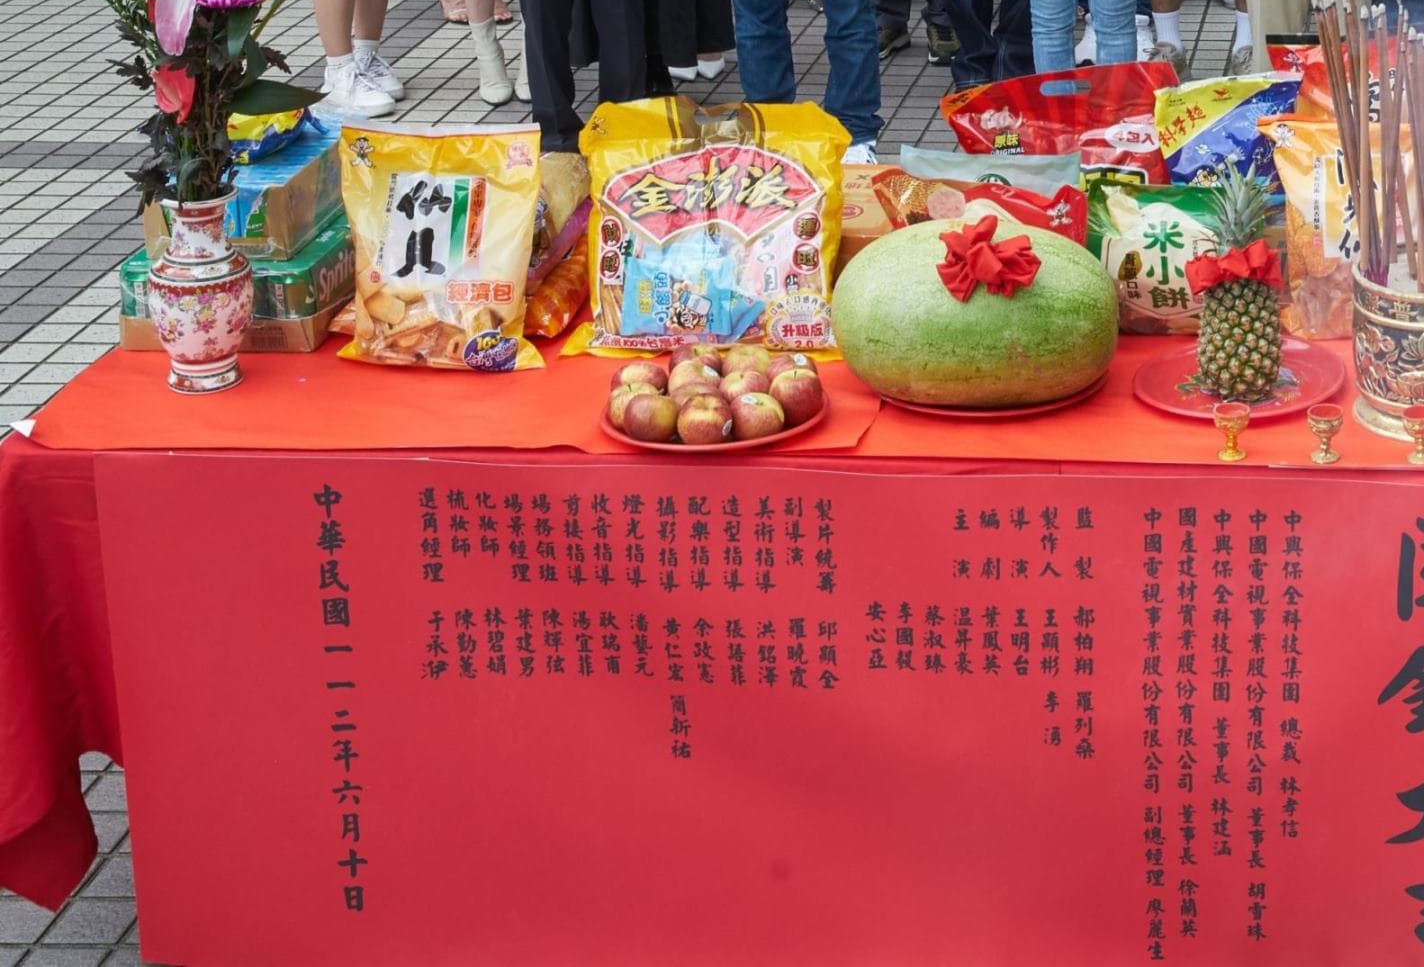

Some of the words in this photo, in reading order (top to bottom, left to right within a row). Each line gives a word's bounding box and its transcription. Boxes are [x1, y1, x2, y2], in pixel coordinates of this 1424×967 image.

[995, 133, 1020, 148] 原味
[446, 279, 514, 304] 經濟包
[1143, 221, 1190, 309] 米小餅
[420, 487, 444, 583] 選角經理
[475, 491, 500, 556] 化妝師
[503, 493, 530, 583] 場景經理
[563, 494, 587, 586] 剪接指導
[591, 493, 614, 586] 收音指導
[623, 494, 646, 588] 燈光指導
[657, 496, 679, 593] 攝影指導
[688, 496, 710, 591] 配樂指導
[722, 495, 743, 591] 造型指導
[754, 496, 775, 593] 美術指導
[784, 497, 805, 563] 副導演
[952, 509, 970, 576] 主演
[979, 509, 1001, 580] 編劇
[1011, 507, 1030, 576] 導演
[1040, 507, 1061, 577] 製作人
[1075, 507, 1094, 580] 監製
[865, 601, 887, 669] 安心亞
[1011, 608, 1030, 676] 王明台
[1212, 509, 1233, 702] 中興保全科技集團
[1282, 510, 1302, 703] 中興保全科技集團
[1142, 507, 1163, 794] 中國電視事業股份有限公司
[1176, 507, 1198, 793] 國產建材實業股份有限公司
[1246, 509, 1268, 796] 中國電視事業股份有限公司
[313, 483, 368, 912] 中華民國一一二年六月十日
[1213, 717, 1230, 784] 董事長
[1143, 807, 1165, 887] 副總經理
[1179, 804, 1196, 865] 董事長
[1248, 807, 1265, 868] 董事長
